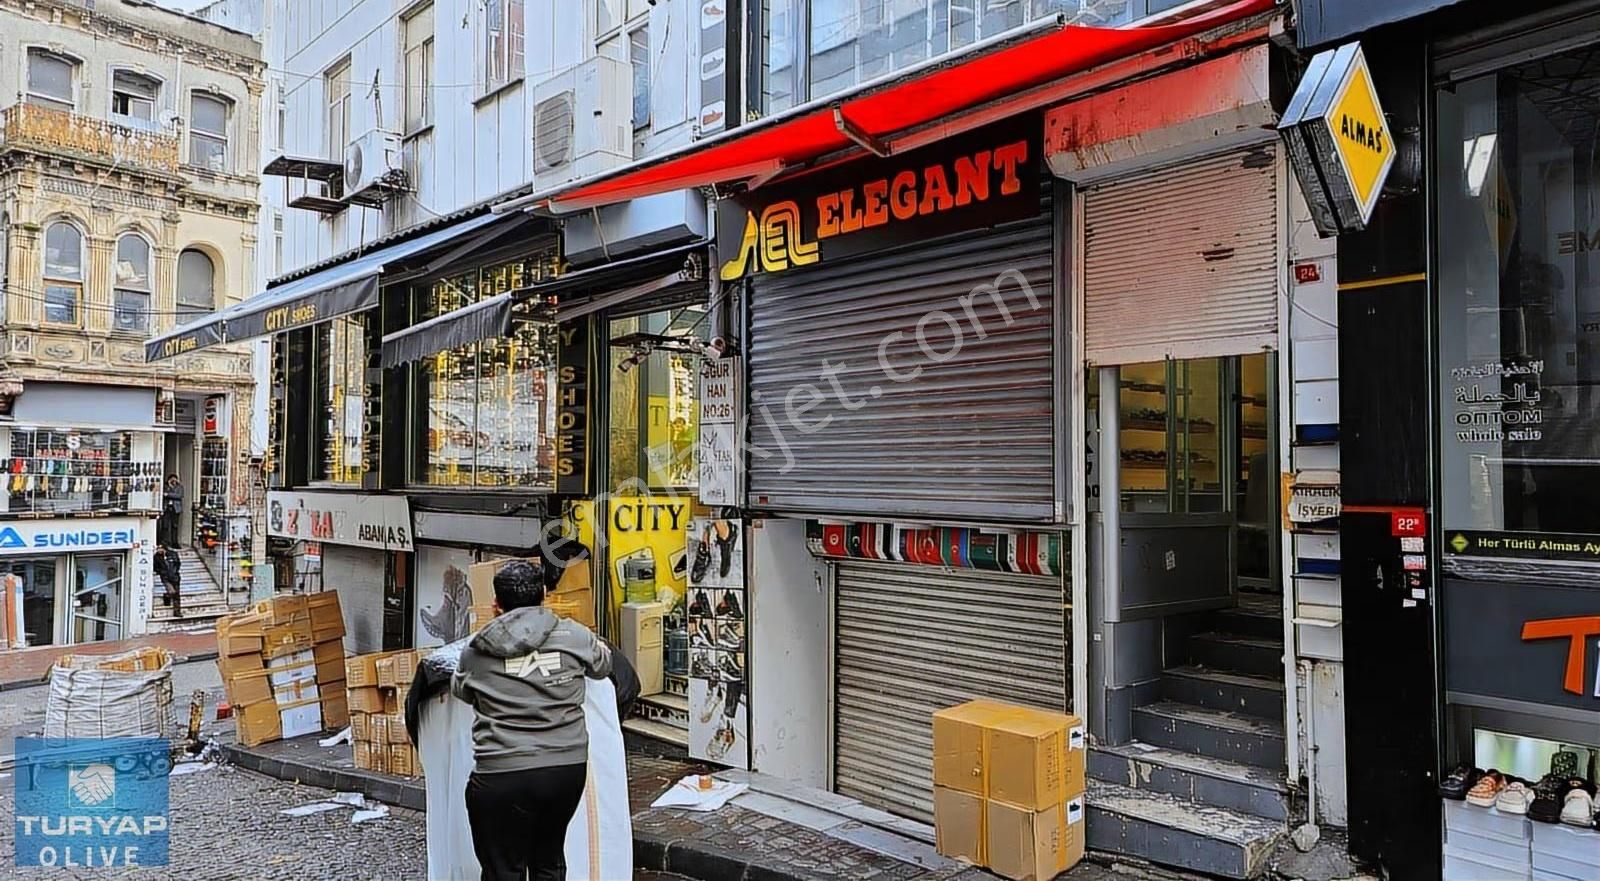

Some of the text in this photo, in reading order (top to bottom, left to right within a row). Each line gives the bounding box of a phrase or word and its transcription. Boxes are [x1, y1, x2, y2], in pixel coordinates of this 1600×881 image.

[1341, 114, 1383, 153] ALMAS
[816, 140, 1028, 239] ELEGANT
[1300, 267, 1315, 279] 24
[266, 306, 289, 331] CITY
[707, 384, 727, 398] HAN
[703, 404, 731, 418] NO:26
[362, 383, 373, 473] SHOES
[559, 366, 577, 477] SHOES
[1456, 427, 1542, 442] whole sale
[1478, 538, 1501, 548] Her
[1503, 539, 1536, 550] Türlü
[1539, 541, 1581, 552] Almas
